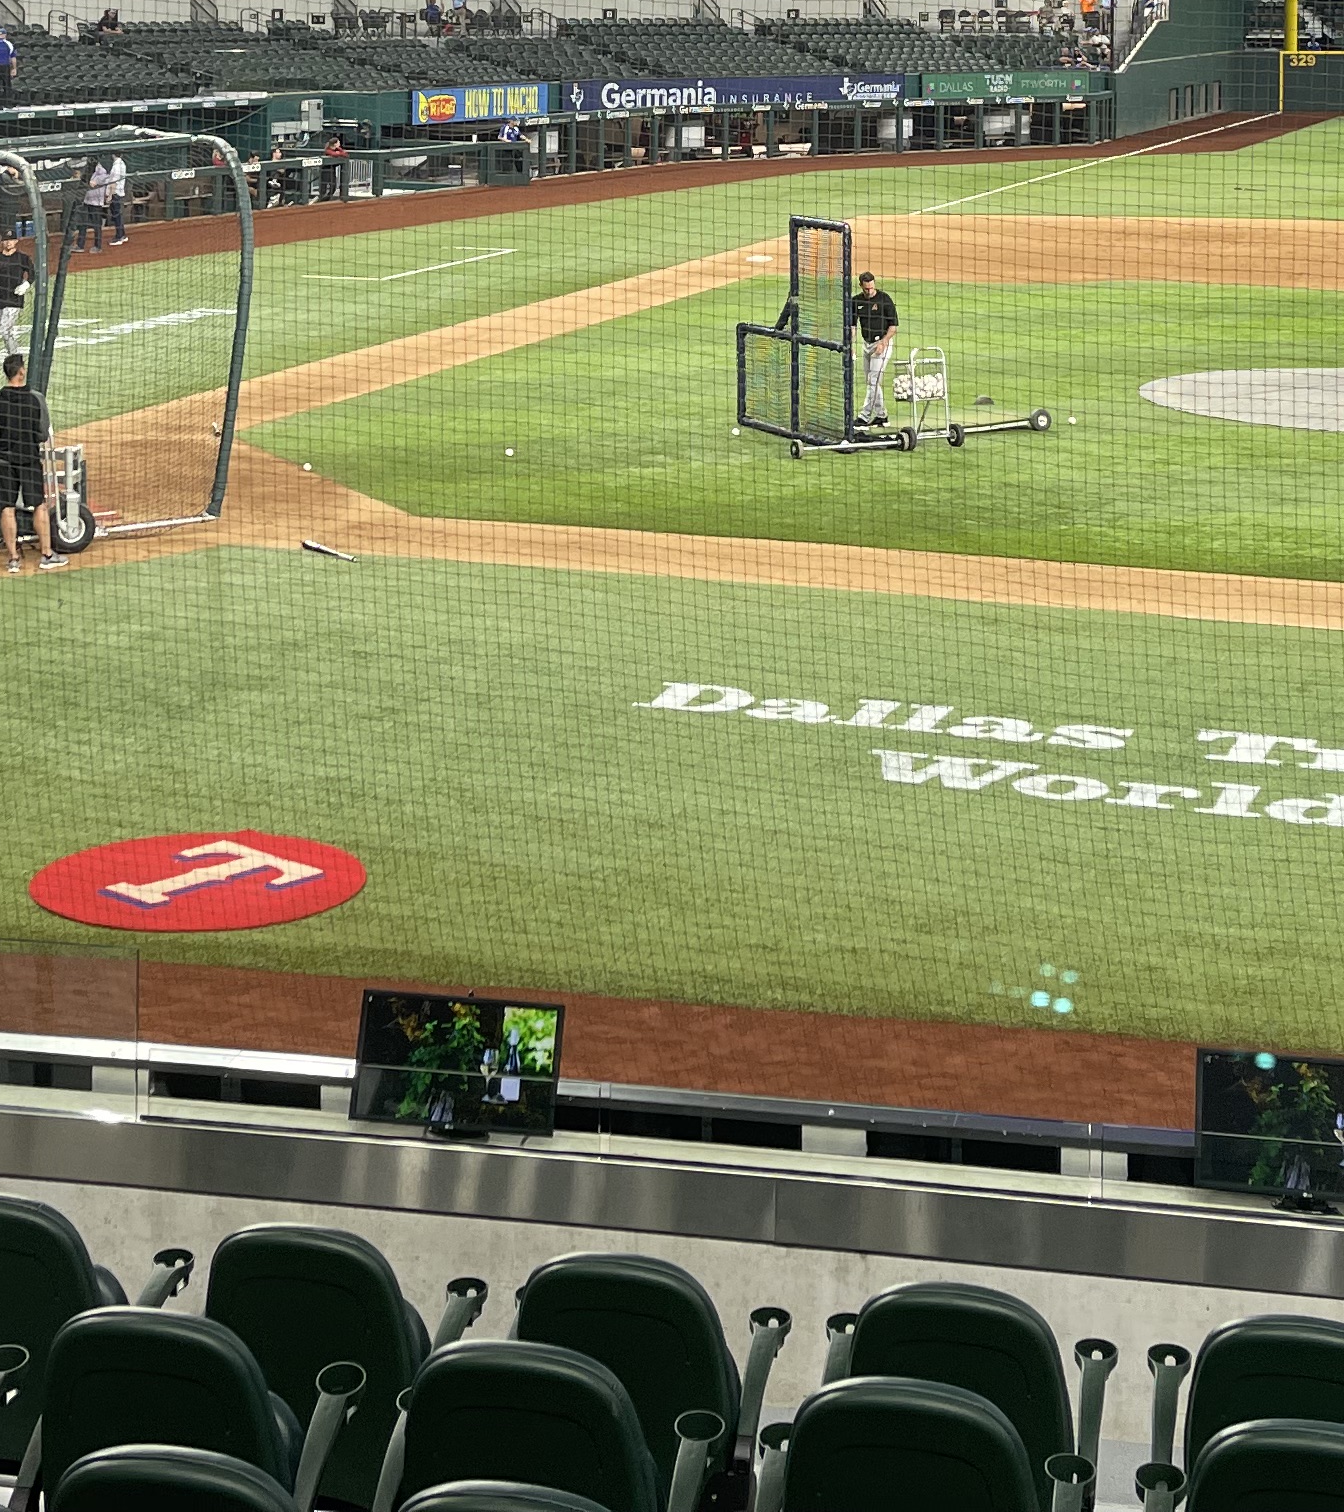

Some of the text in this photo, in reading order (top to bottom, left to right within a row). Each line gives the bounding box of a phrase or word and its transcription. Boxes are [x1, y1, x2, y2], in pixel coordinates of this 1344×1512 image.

[1290, 55, 1315, 68] 329
[601, 80, 813, 109] Germania INSURANCE
[940, 81, 973, 92] DALLAS
[464, 89, 489, 118] HOW
[492, 88, 504, 117] TO
[634, 680, 1133, 751] Dallas
